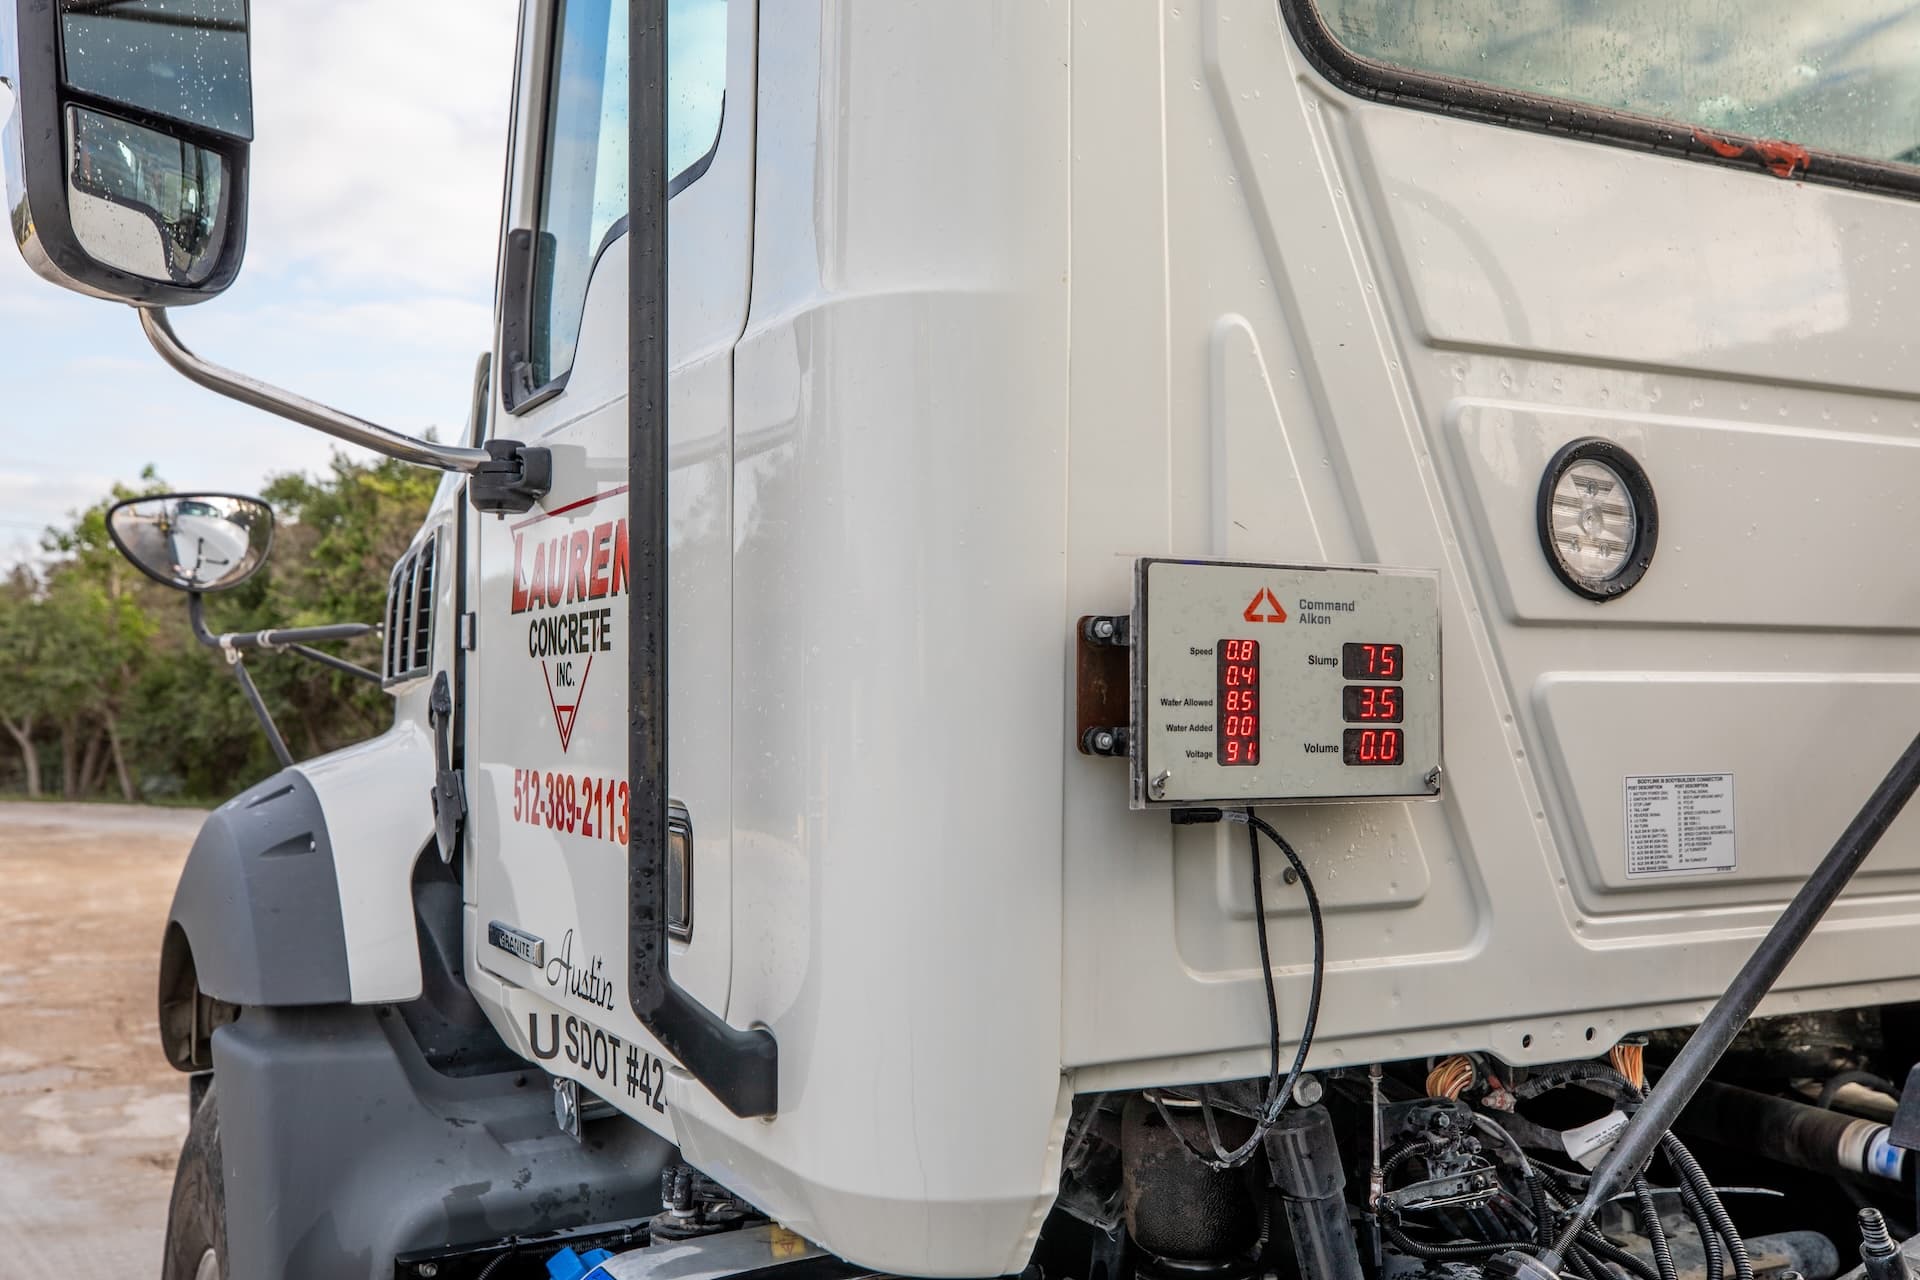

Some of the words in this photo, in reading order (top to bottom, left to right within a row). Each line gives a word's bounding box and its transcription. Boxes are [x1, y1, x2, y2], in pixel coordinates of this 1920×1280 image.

[1299, 599, 1355, 612] Command
[1299, 613, 1331, 625] Alkon
[529, 607, 611, 659] CONCRETE
[1190, 647, 1213, 656] Speed
[1226, 640, 1253, 661] 0.8
[1362, 645, 1395, 676] 75
[1308, 655, 1339, 668] Slump
[556, 661, 575, 688] INC.
[1226, 665, 1253, 686] 0.4
[1160, 698, 1182, 707] Water
[1183, 698, 1213, 707] Allowed
[1226, 690, 1253, 711] 8.5
[1361, 688, 1395, 718] 3.5
[1166, 724, 1187, 733] Water
[1189, 724, 1213, 733] Added
[1185, 749, 1213, 760] Voltage
[1304, 742, 1339, 754] Volume
[1360, 731, 1396, 761] 0.0
[514, 768, 630, 846] 512-389-2113
[500, 934, 530, 958] GRANITE
[546, 928, 615, 1011] Austin
[626, 1045, 668, 1125] #42
